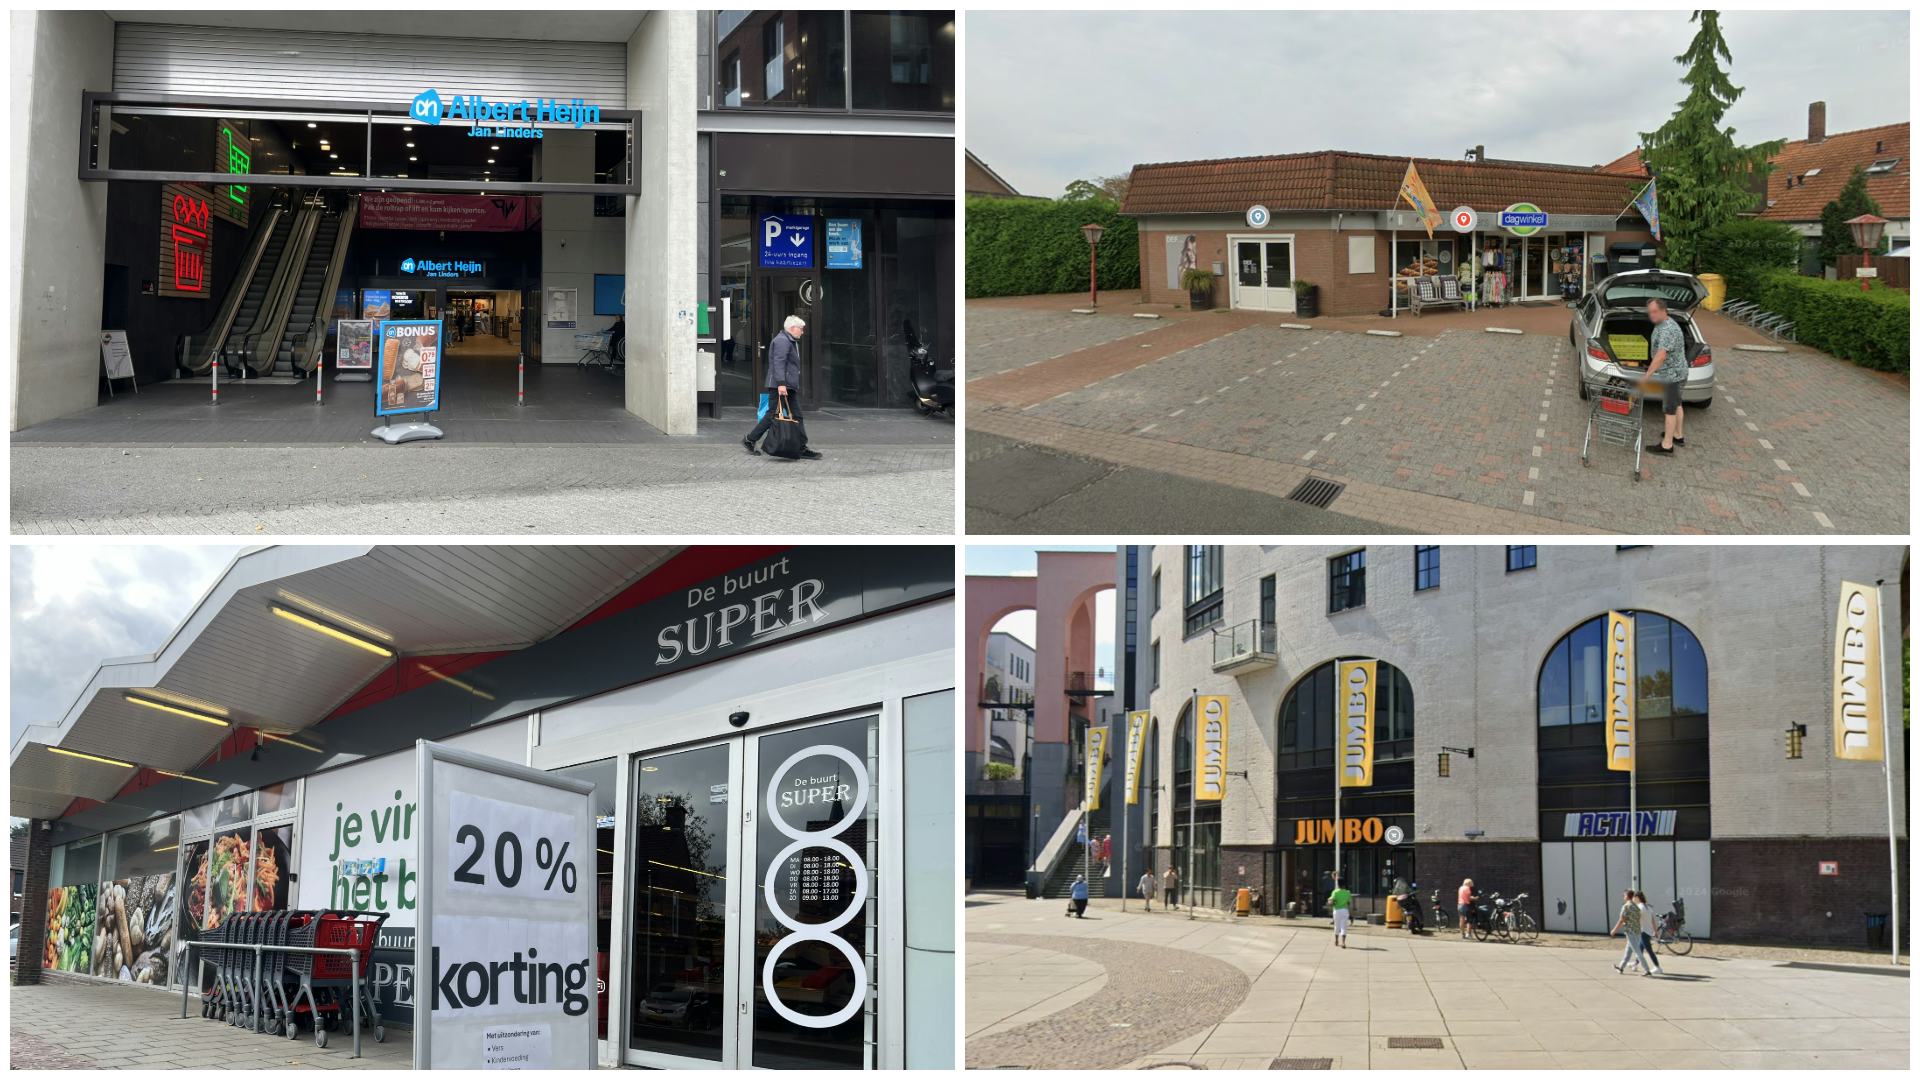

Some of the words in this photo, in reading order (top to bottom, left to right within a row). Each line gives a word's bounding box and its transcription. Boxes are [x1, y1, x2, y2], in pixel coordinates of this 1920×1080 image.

[448, 96, 531, 121] Albert
[537, 98, 600, 128] Heijn
[468, 126, 492, 138] Jan
[496, 126, 544, 138] Linders
[766, 220, 782, 247] P
[1504, 214, 1545, 226] dagwinkel
[417, 261, 452, 271] Albert
[454, 262, 482, 273] Heijn
[396, 326, 435, 337] BONUS
[688, 586, 715, 608] De
[724, 557, 790, 595] buurt
[655, 578, 830, 666] SUPER
[1345, 666, 1368, 780] JUMBO
[1126, 716, 1143, 800] JUMBO
[1204, 699, 1222, 794] JUMBO
[795, 778, 807, 786] De
[810, 774, 838, 784] buurt
[1088, 732, 1102, 804] JUMBO
[781, 784, 850, 808] SUPER
[329, 802, 362, 861] je
[1295, 817, 1383, 844] JUMBO
[1578, 810, 1660, 836] ACTION
[454, 824, 522, 888] 20
[536, 837, 576, 893] %
[330, 865, 389, 910] het
[432, 946, 589, 1016] korting
[498, 1030, 530, 1038] uitzondering
